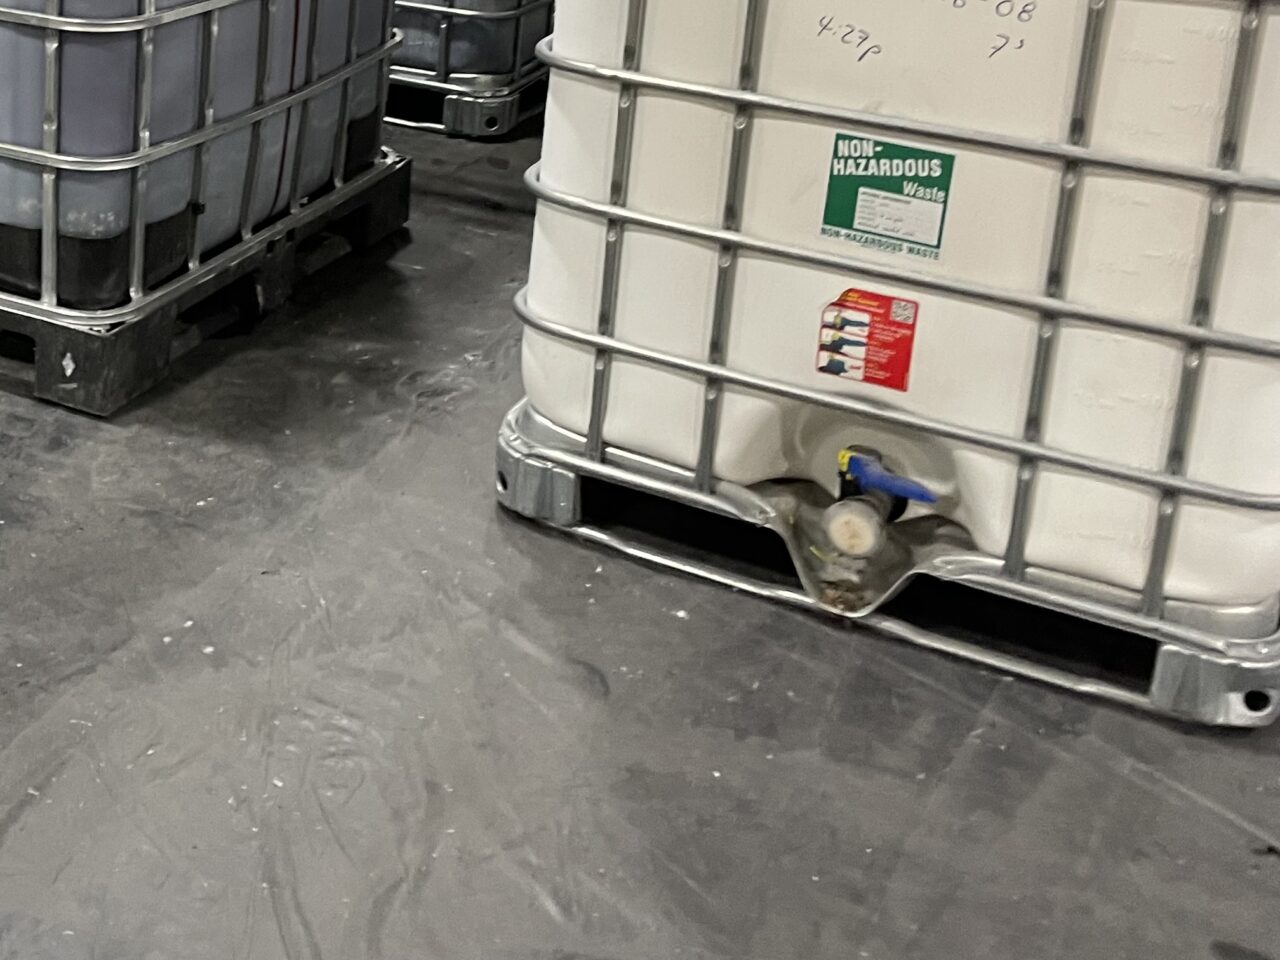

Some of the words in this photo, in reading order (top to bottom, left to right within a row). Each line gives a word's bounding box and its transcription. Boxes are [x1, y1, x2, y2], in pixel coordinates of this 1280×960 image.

[837, 138, 883, 158] NON-
[832, 157, 942, 178] HAZARDOUS
[902, 180, 945, 202] Waste
